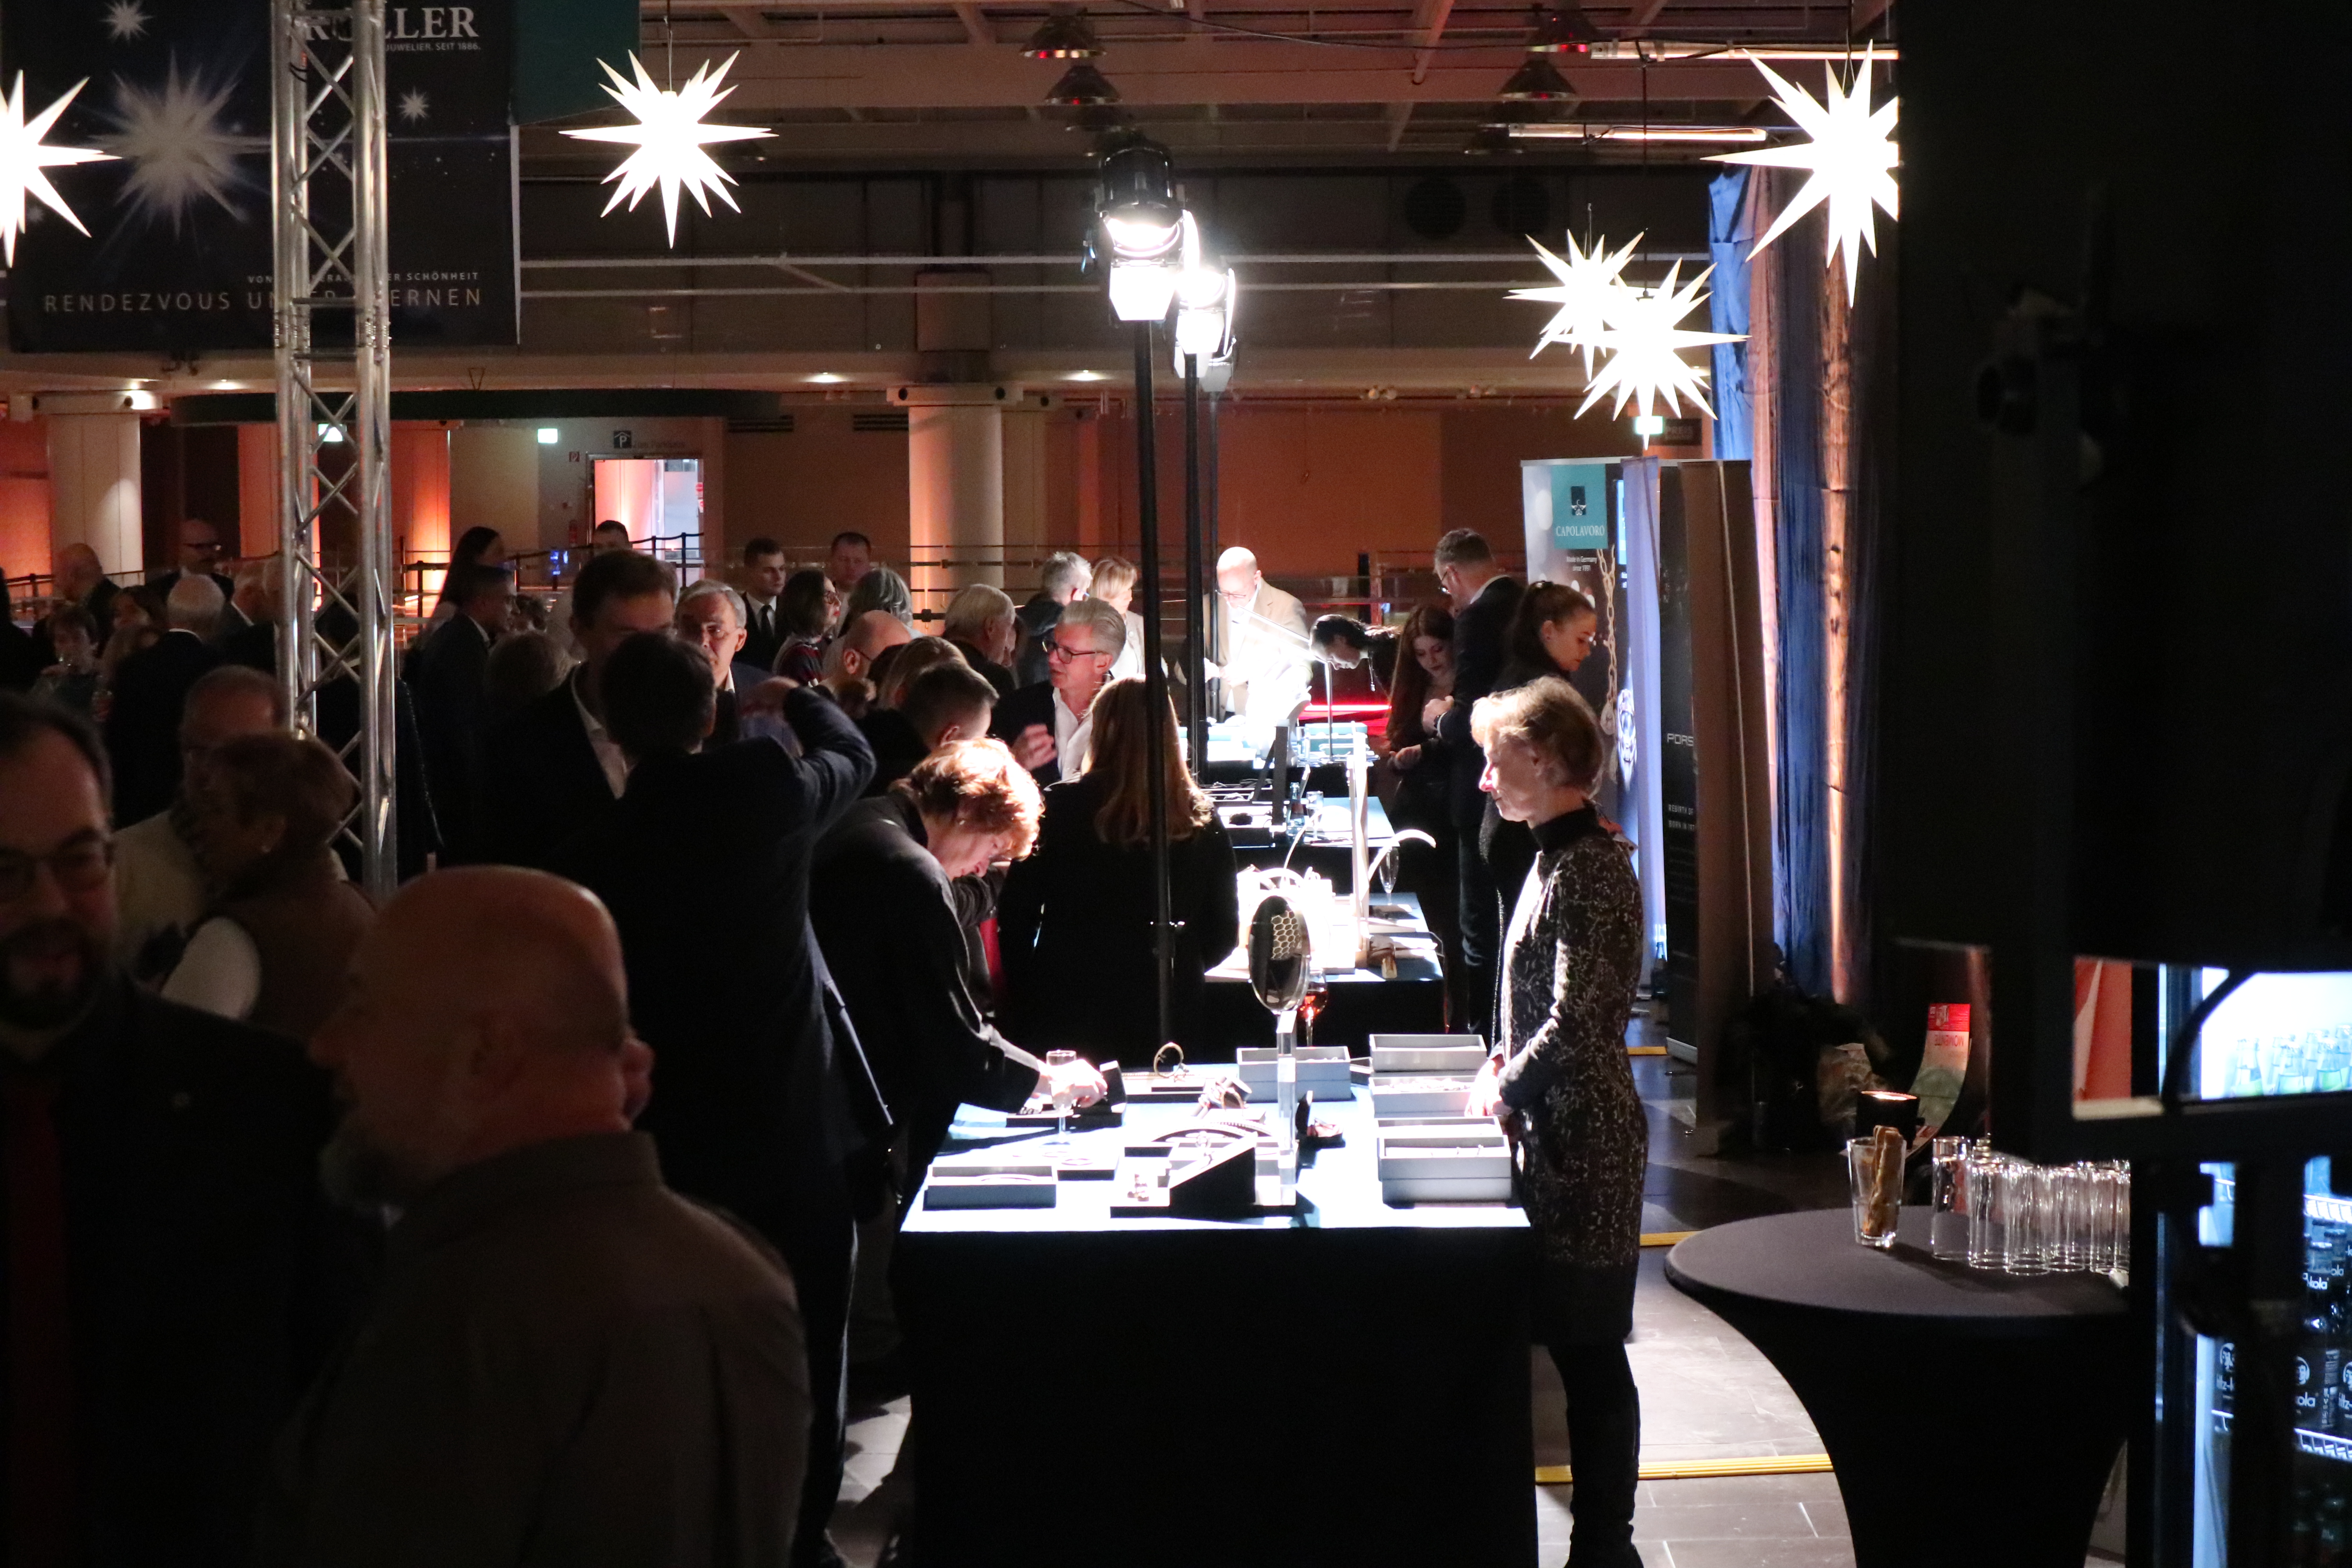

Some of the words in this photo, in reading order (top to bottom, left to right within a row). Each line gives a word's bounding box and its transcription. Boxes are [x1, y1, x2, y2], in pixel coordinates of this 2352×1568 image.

[435, 42, 454, 51] SEIT
[247, 275, 272, 283] VON
[407, 271, 478, 281] SCHÖNHEIT
[45, 292, 230, 312] RENDEZVOUS
[390, 289, 480, 307] ERNEN
[1556, 525, 1605, 536] CAPOLAVORO
[1581, 556, 1597, 564] Germany
